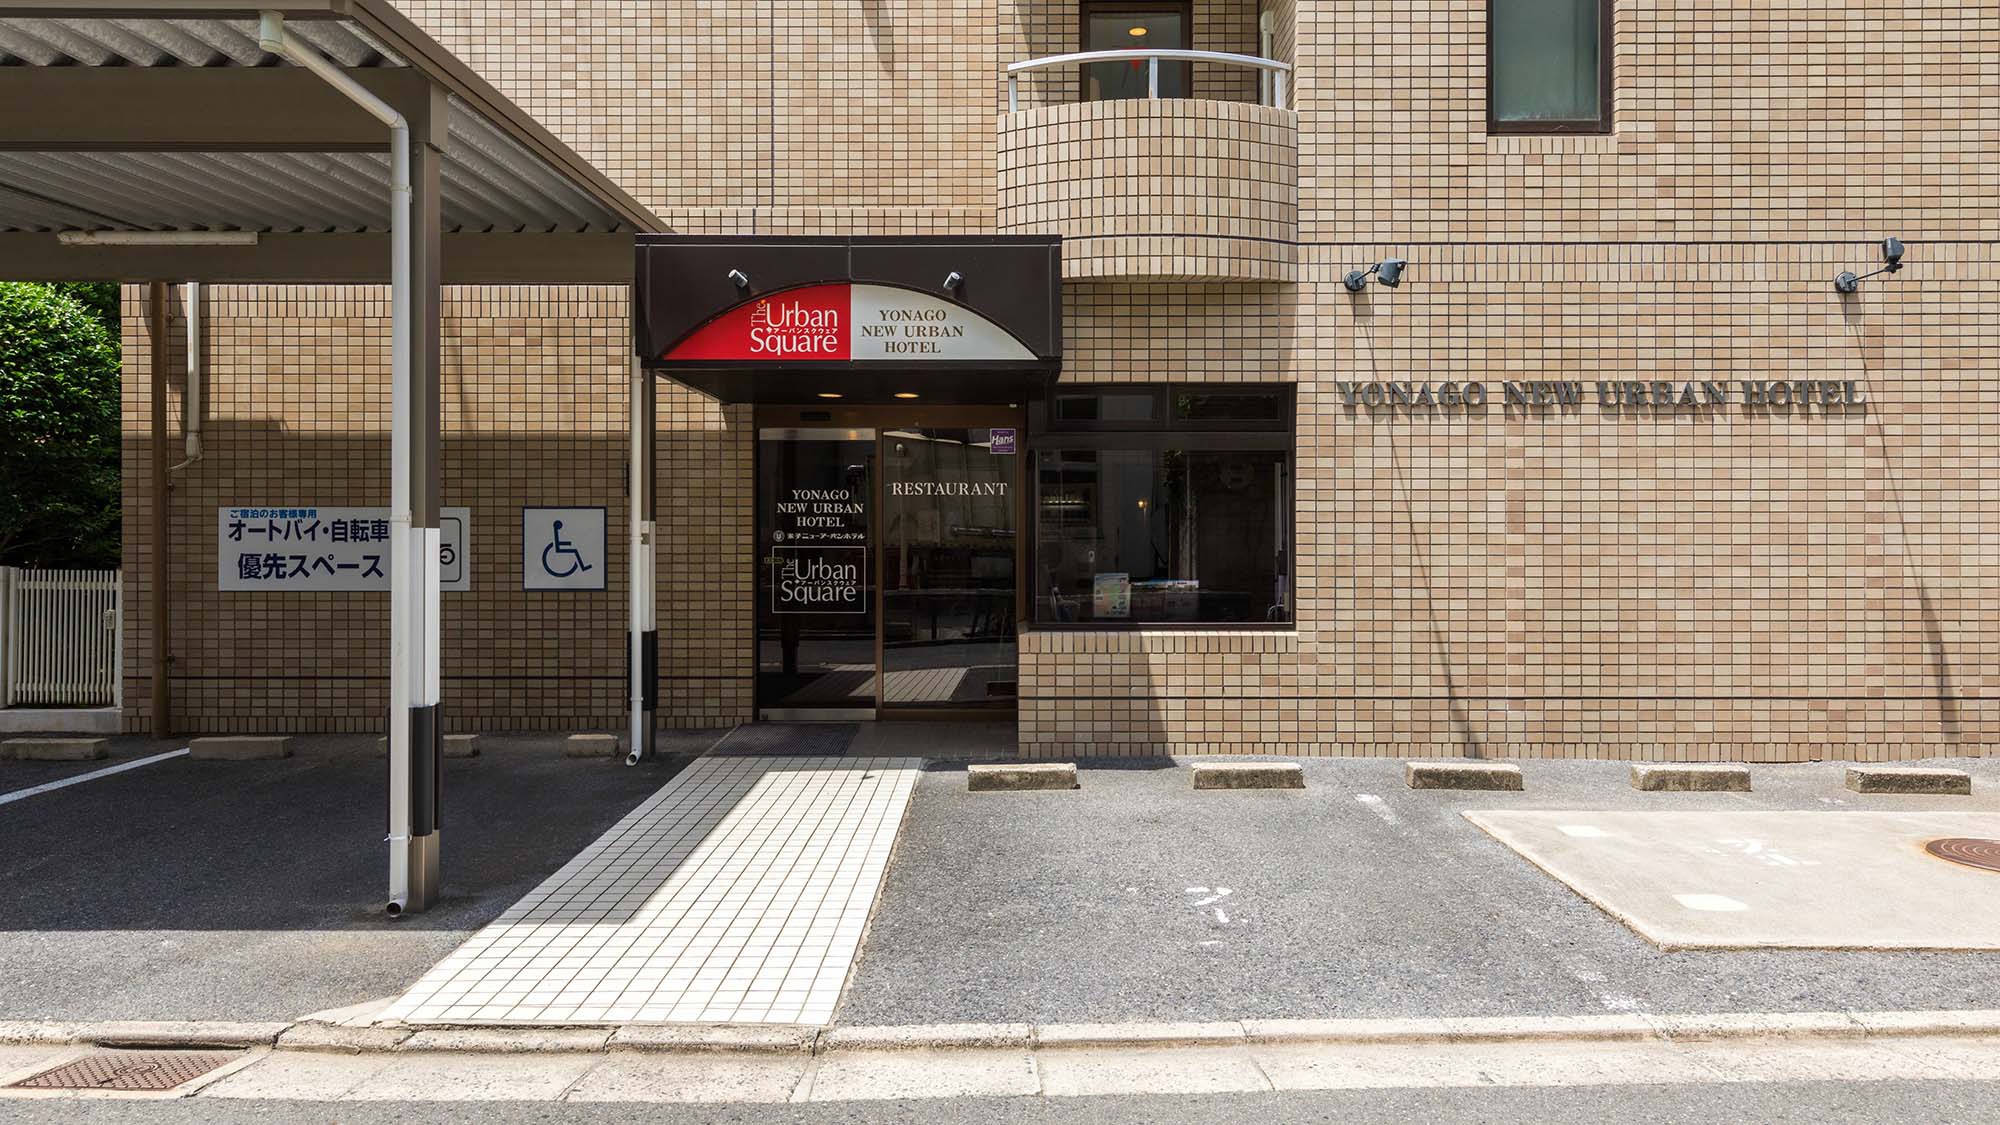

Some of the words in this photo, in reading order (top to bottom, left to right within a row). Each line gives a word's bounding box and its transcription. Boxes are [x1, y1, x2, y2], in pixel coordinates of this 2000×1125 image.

[751, 303, 766, 327] The
[766, 301, 838, 327] Urban
[879, 310, 946, 322] YONAGO
[862, 326, 897, 338] NEW
[905, 326, 964, 338] URBAN
[750, 328, 838, 356] Square
[885, 342, 941, 354] HOTEL
[1337, 380, 1487, 406] YONAGO
[1502, 380, 1583, 406] NEW
[1596, 380, 1729, 406] URBAN
[1741, 380, 1866, 406] HOTEL
[991, 435, 1014, 445] Hans
[792, 490, 849, 501] YONAGO
[892, 483, 1008, 496] RESTAURANT
[230, 509, 317, 519] ご宿泊のお客様専用
[777, 503, 808, 514] NEW
[813, 503, 864, 514] URBAN
[228, 519, 389, 542] オートバイ・自転車
[797, 517, 845, 528] HOTEL
[238, 553, 384, 579] 優先スペース
[781, 558, 795, 580] The
[795, 557, 856, 580] Urban
[781, 580, 856, 604] Square
